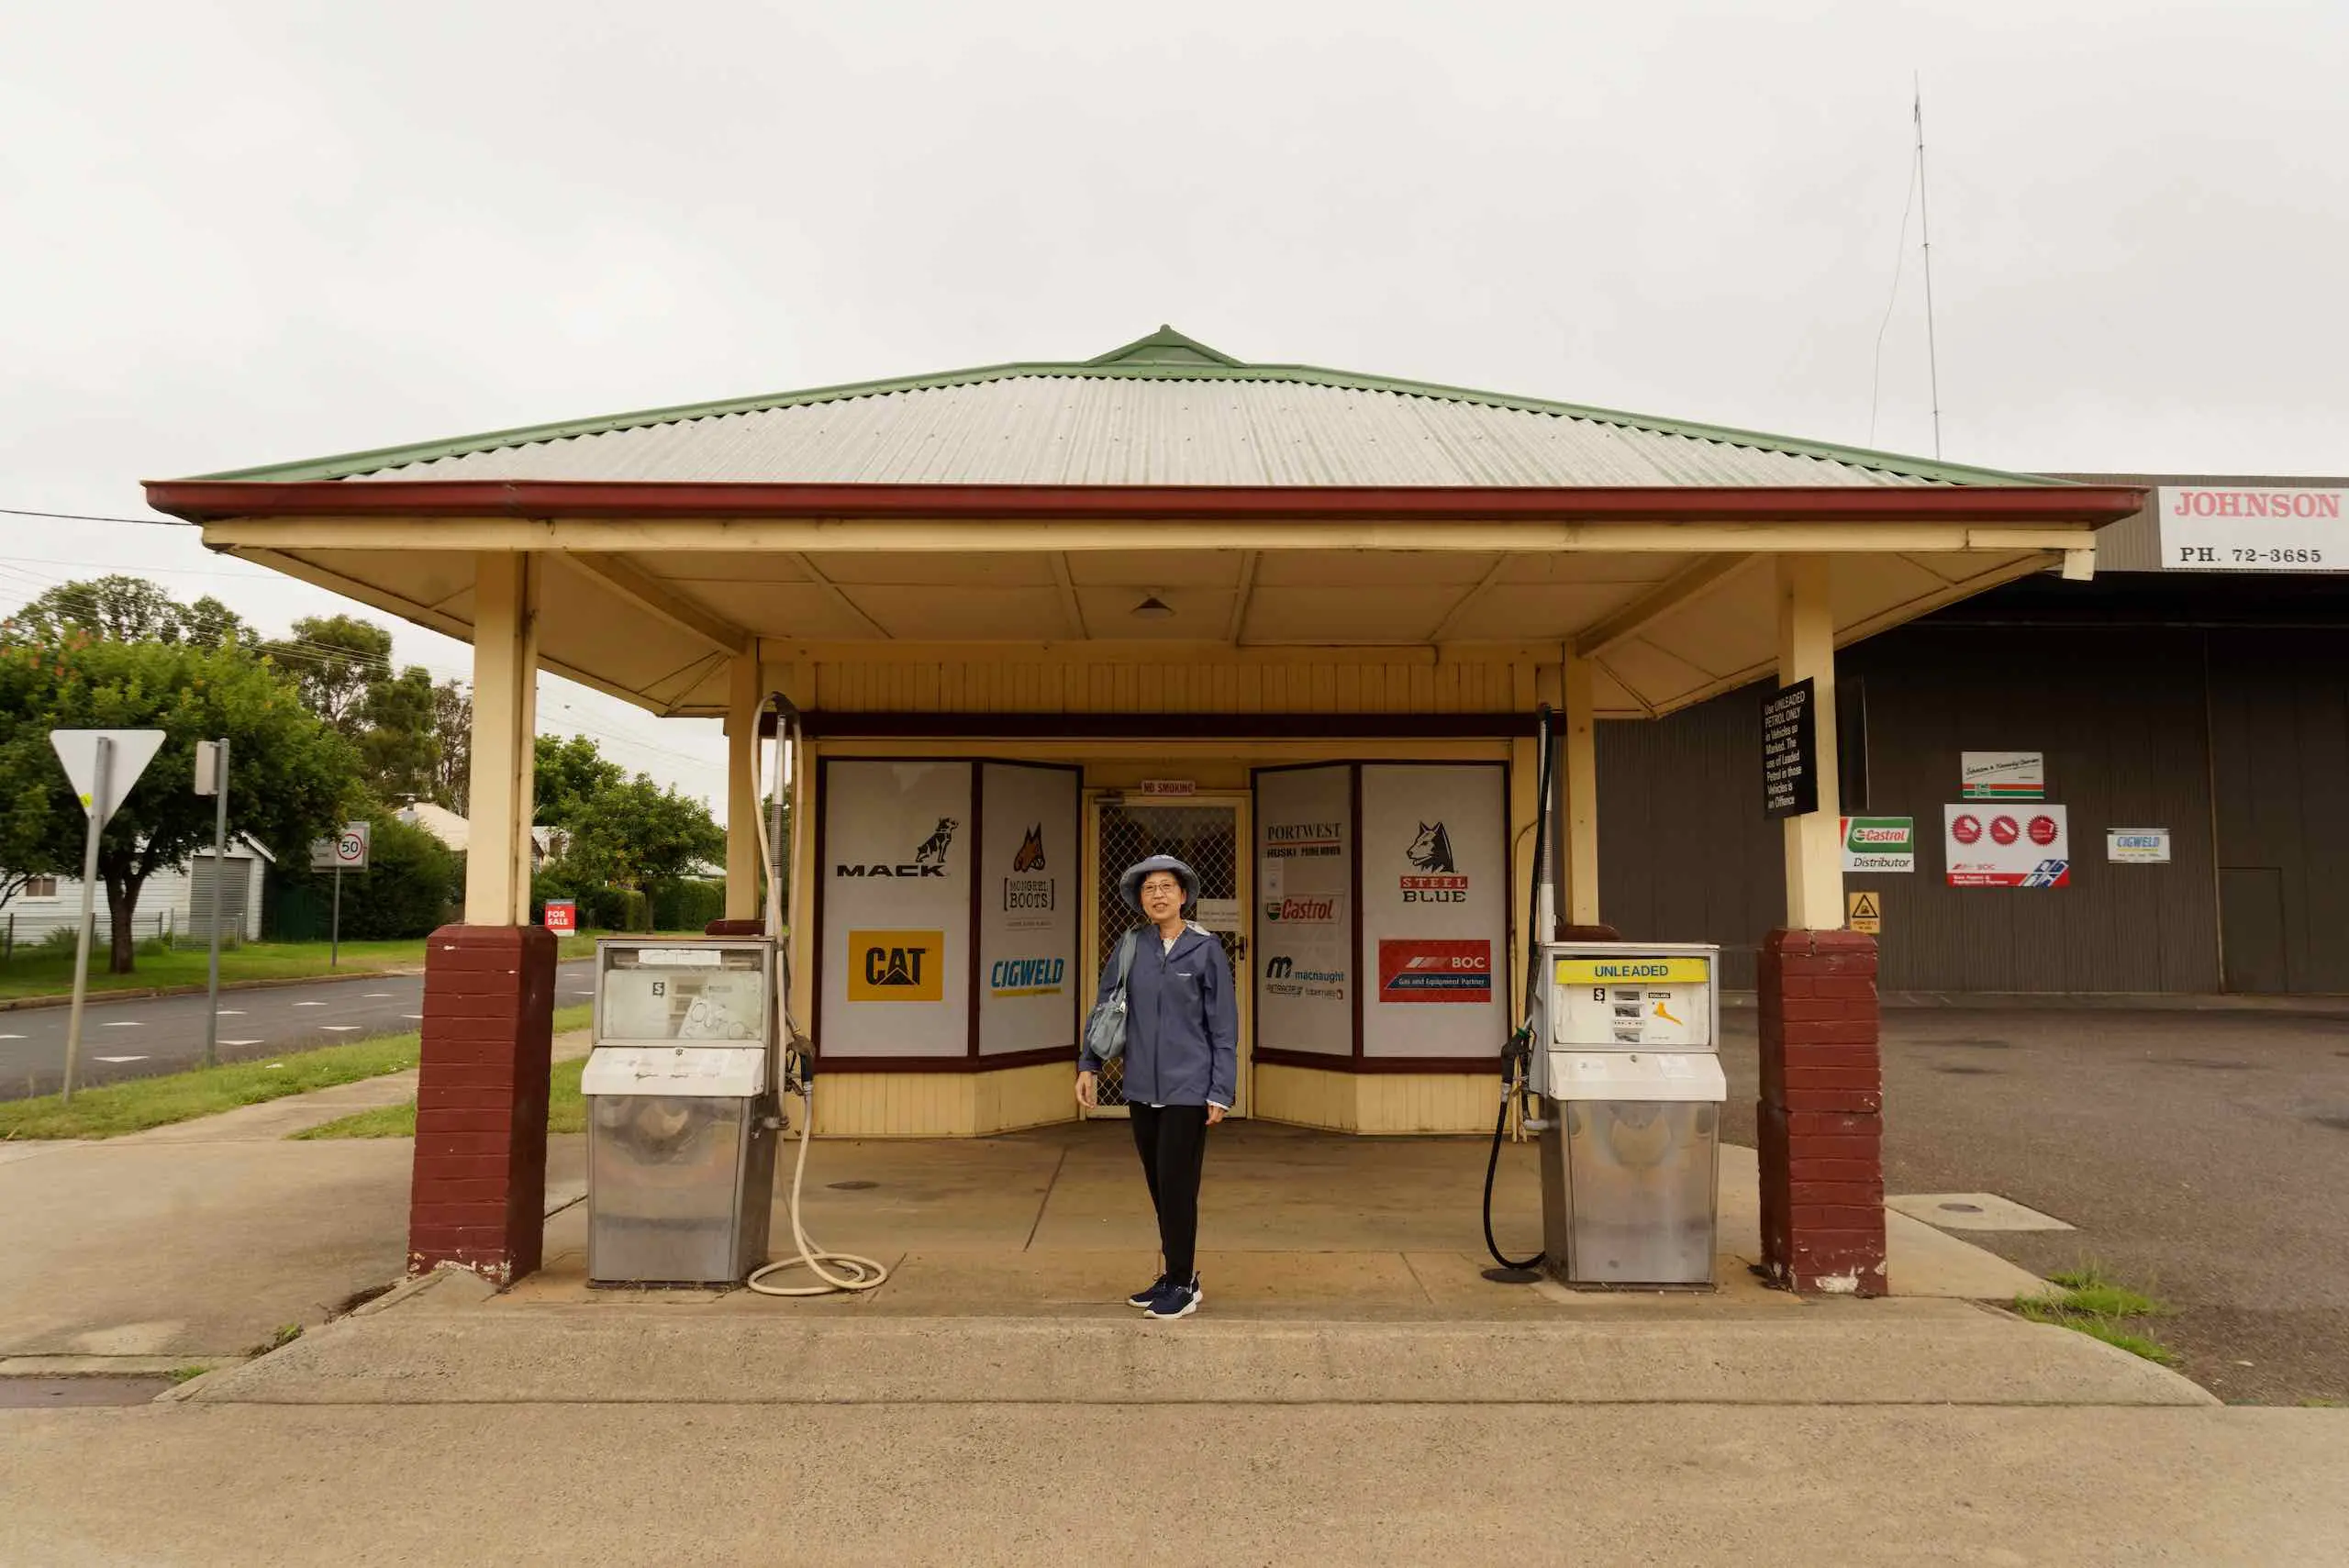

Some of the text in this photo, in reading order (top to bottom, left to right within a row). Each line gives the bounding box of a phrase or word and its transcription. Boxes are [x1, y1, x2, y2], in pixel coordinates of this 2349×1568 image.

[2175, 492, 2340, 517] JOHNSON
[2180, 548, 2321, 562] PH. 72-3685
[1765, 691, 1805, 716] Use UNLEADED
[1765, 706, 1800, 728] PETROL ONLY
[1786, 737, 1797, 749] The
[1144, 782, 1193, 794] NO SMOKING
[1268, 824, 1341, 840] PORTWEST
[1866, 829, 1905, 841] Castrol
[341, 841, 358, 853] 50
[1854, 857, 1910, 867] Distributor
[837, 864, 947, 877] MACK
[1010, 880, 1048, 892] MONGREL
[1402, 878, 1466, 887] STEEL
[1009, 893, 1048, 908] BOOTS
[1402, 890, 1467, 903] BLUE
[1282, 898, 1334, 919] Castrol
[866, 947, 926, 985] CAT
[1452, 957, 1486, 968] BOC
[992, 958, 1064, 987] CIGWELD
[1295, 971, 1344, 984] macnaught
[1595, 965, 1669, 977] UNLEADED
[1413, 976, 1424, 984] and
[1426, 976, 1459, 986] Equipment
[1462, 976, 1485, 984] Partner
